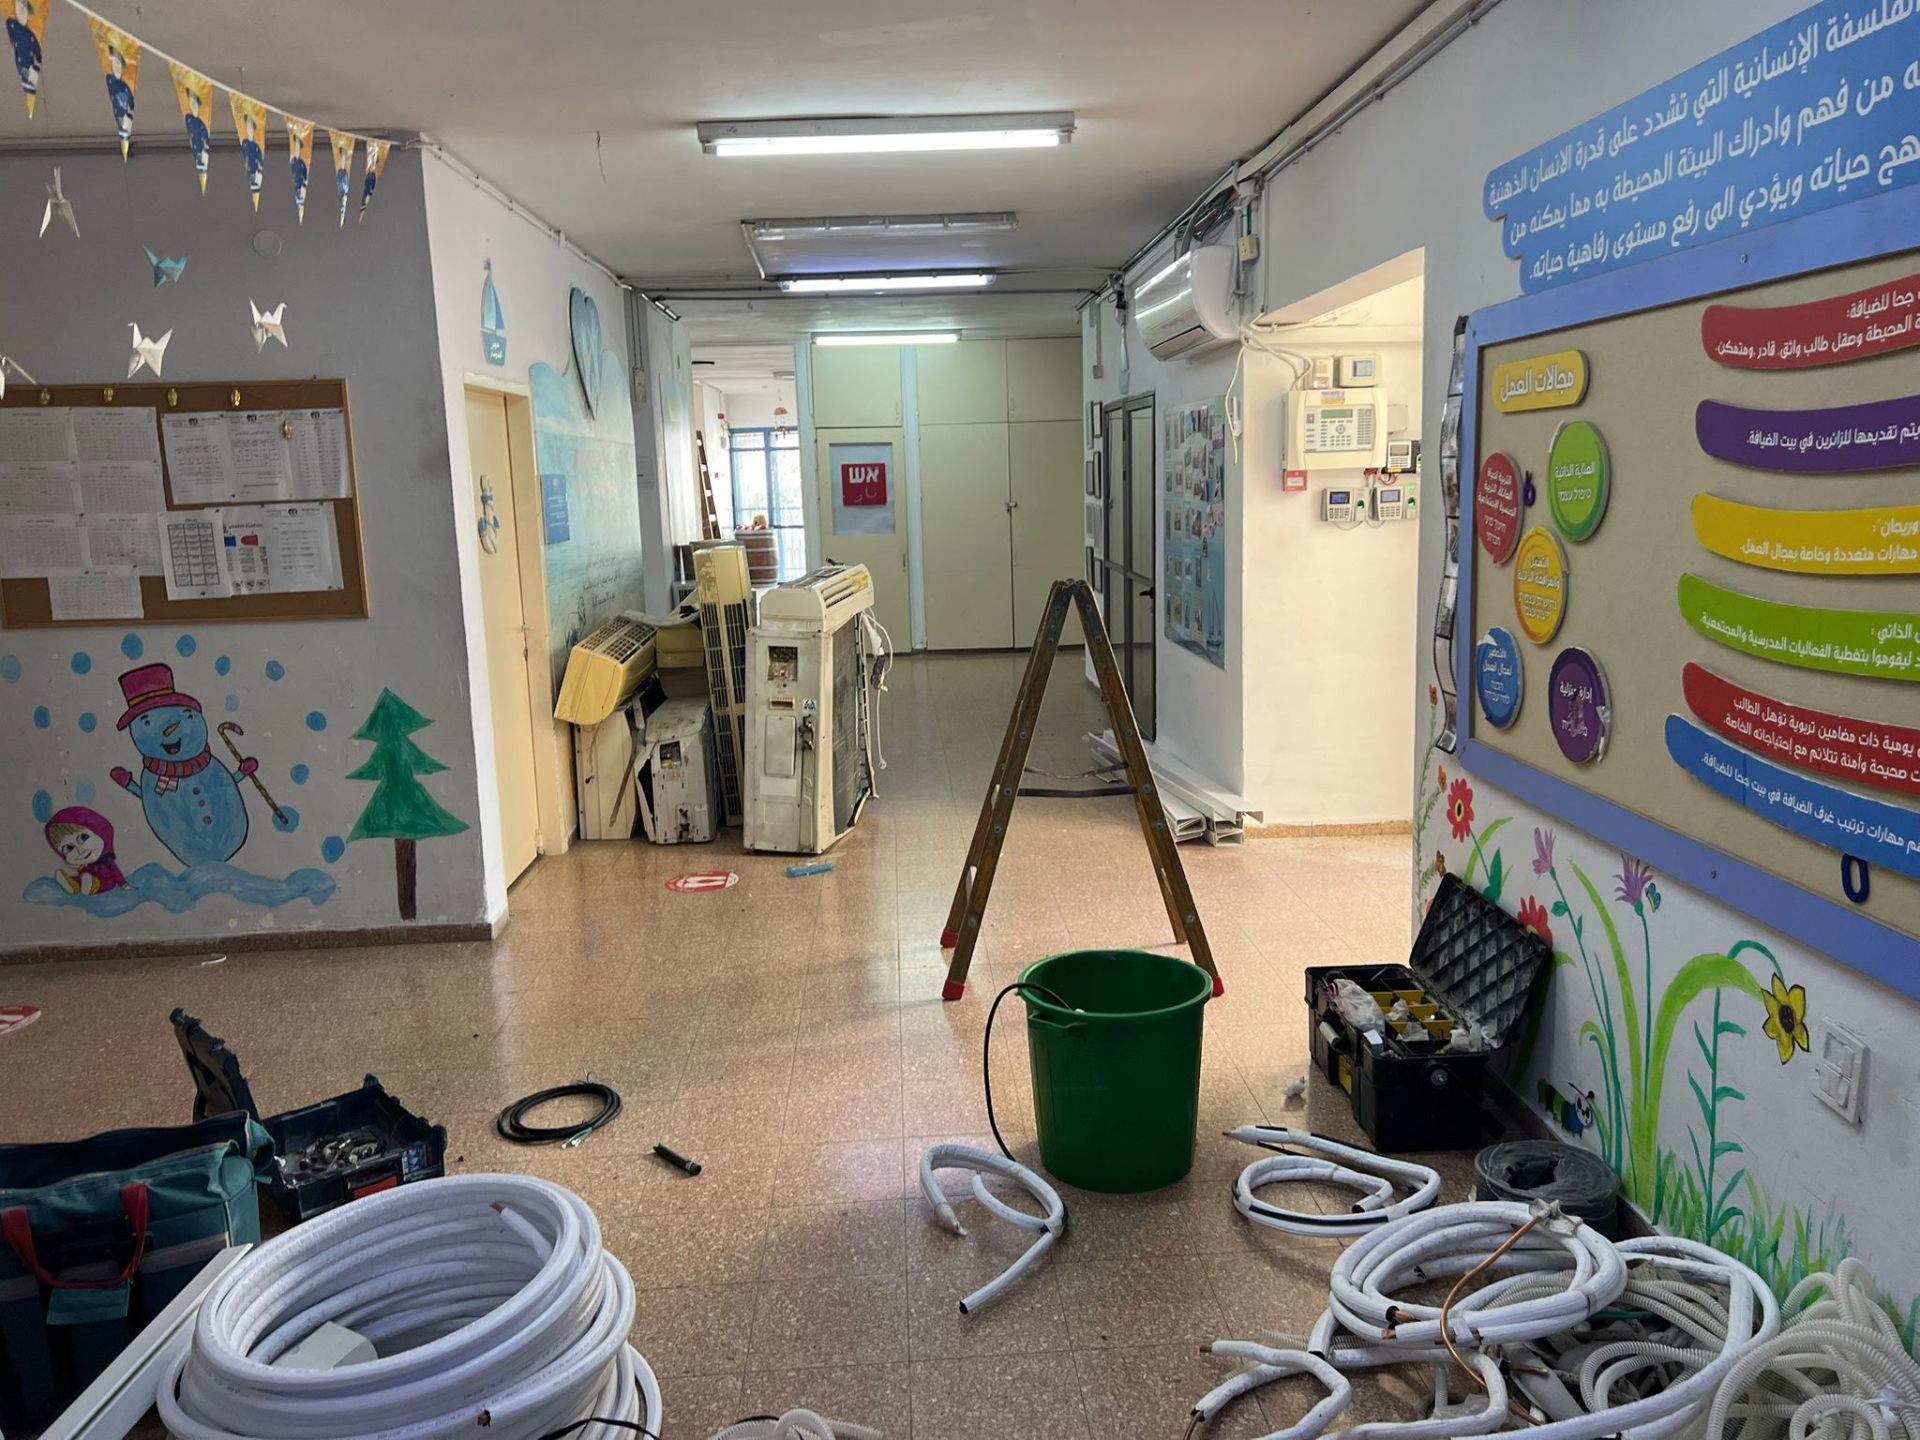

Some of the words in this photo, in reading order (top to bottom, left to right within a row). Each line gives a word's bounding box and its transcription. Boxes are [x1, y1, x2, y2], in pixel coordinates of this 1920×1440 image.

[1733, 21, 1819, 99] الإنسانية
[1693, 66, 1729, 126] التي
[1855, 75, 1895, 116] من
[1642, 92, 1688, 136] تشدد
[1796, 77, 1849, 147] فهم
[1608, 116, 1639, 157] على
[1728, 104, 1791, 158] وادراك
[1575, 127, 1605, 171] قدرة
[1677, 128, 1724, 179] البيئة
[1529, 143, 1572, 192] الانسان
[1612, 151, 1673, 202] المحيطة
[1809, 147, 1871, 192] حياته
[1488, 165, 1528, 210] الذهنية
[1569, 191, 1591, 219] مما
[1594, 188, 1609, 213] به
[1704, 184, 1735, 231] الى
[1738, 172, 1804, 228] ويؤدي
[1529, 202, 1566, 234] يمكنه
[1670, 199, 1700, 248] رفع
[1510, 219, 1527, 246] من
[1612, 220, 1667, 259] مستوى
[1567, 230, 1609, 272] رفاهية
[1529, 248, 1564, 280] حياته.
[1846, 292, 1890, 319] للضيافة:
[1892, 290, 1915, 308] جحا
[1865, 314, 1912, 343] المحيطة
[1803, 334, 1829, 357] طالب
[1831, 332, 1863, 354] وصقل
[1500, 369, 1533, 402] العمل
[1534, 364, 1574, 395] مجالات
[1780, 434, 1797, 451] بيت
[1799, 431, 1814, 454] في
[1816, 429, 1852, 450] للزائرين
[1854, 425, 1898, 447] تقديمها
[848, 466, 880, 484] אש
[1771, 543, 1798, 563] بمجال
[1799, 546, 1831, 565] وخاصة
[1833, 546, 1874, 562] متعددة
[1877, 543, 1918, 564] مهارات
[1748, 629, 1787, 650] المدرسية
[1877, 622, 1912, 645] الذاتي
[1788, 640, 1832, 659] الفعاليات
[1833, 646, 1869, 667] بتغطية
[1872, 650, 1912, 670] ليقوموا
[1733, 696, 1761, 717] الطالب
[1762, 707, 1787, 727] تؤهل
[1723, 713, 1752, 737] الخاصة.
[1789, 714, 1816, 736] تربوية
[1818, 724, 1856, 743] مضامين
[1753, 727, 1793, 754] إحتياجاته
[1858, 731, 1880, 748] ذات
[1882, 735, 1914, 758] يومية
[1794, 744, 1808, 759] مع
[1809, 746, 1838, 764] تتلائم
[1840, 752, 1867, 774] وآمنة
[1734, 768, 1750, 788] جحا
[1869, 758, 1908, 780] صحيحة
[1751, 779, 1767, 795] بيت
[1768, 787, 1781, 805] في
[1782, 791, 1813, 816] الضيافة
[1814, 806, 1835, 825] غرف
[1837, 816, 1864, 835] ترتيب
[1866, 825, 1904, 847] مهارات
